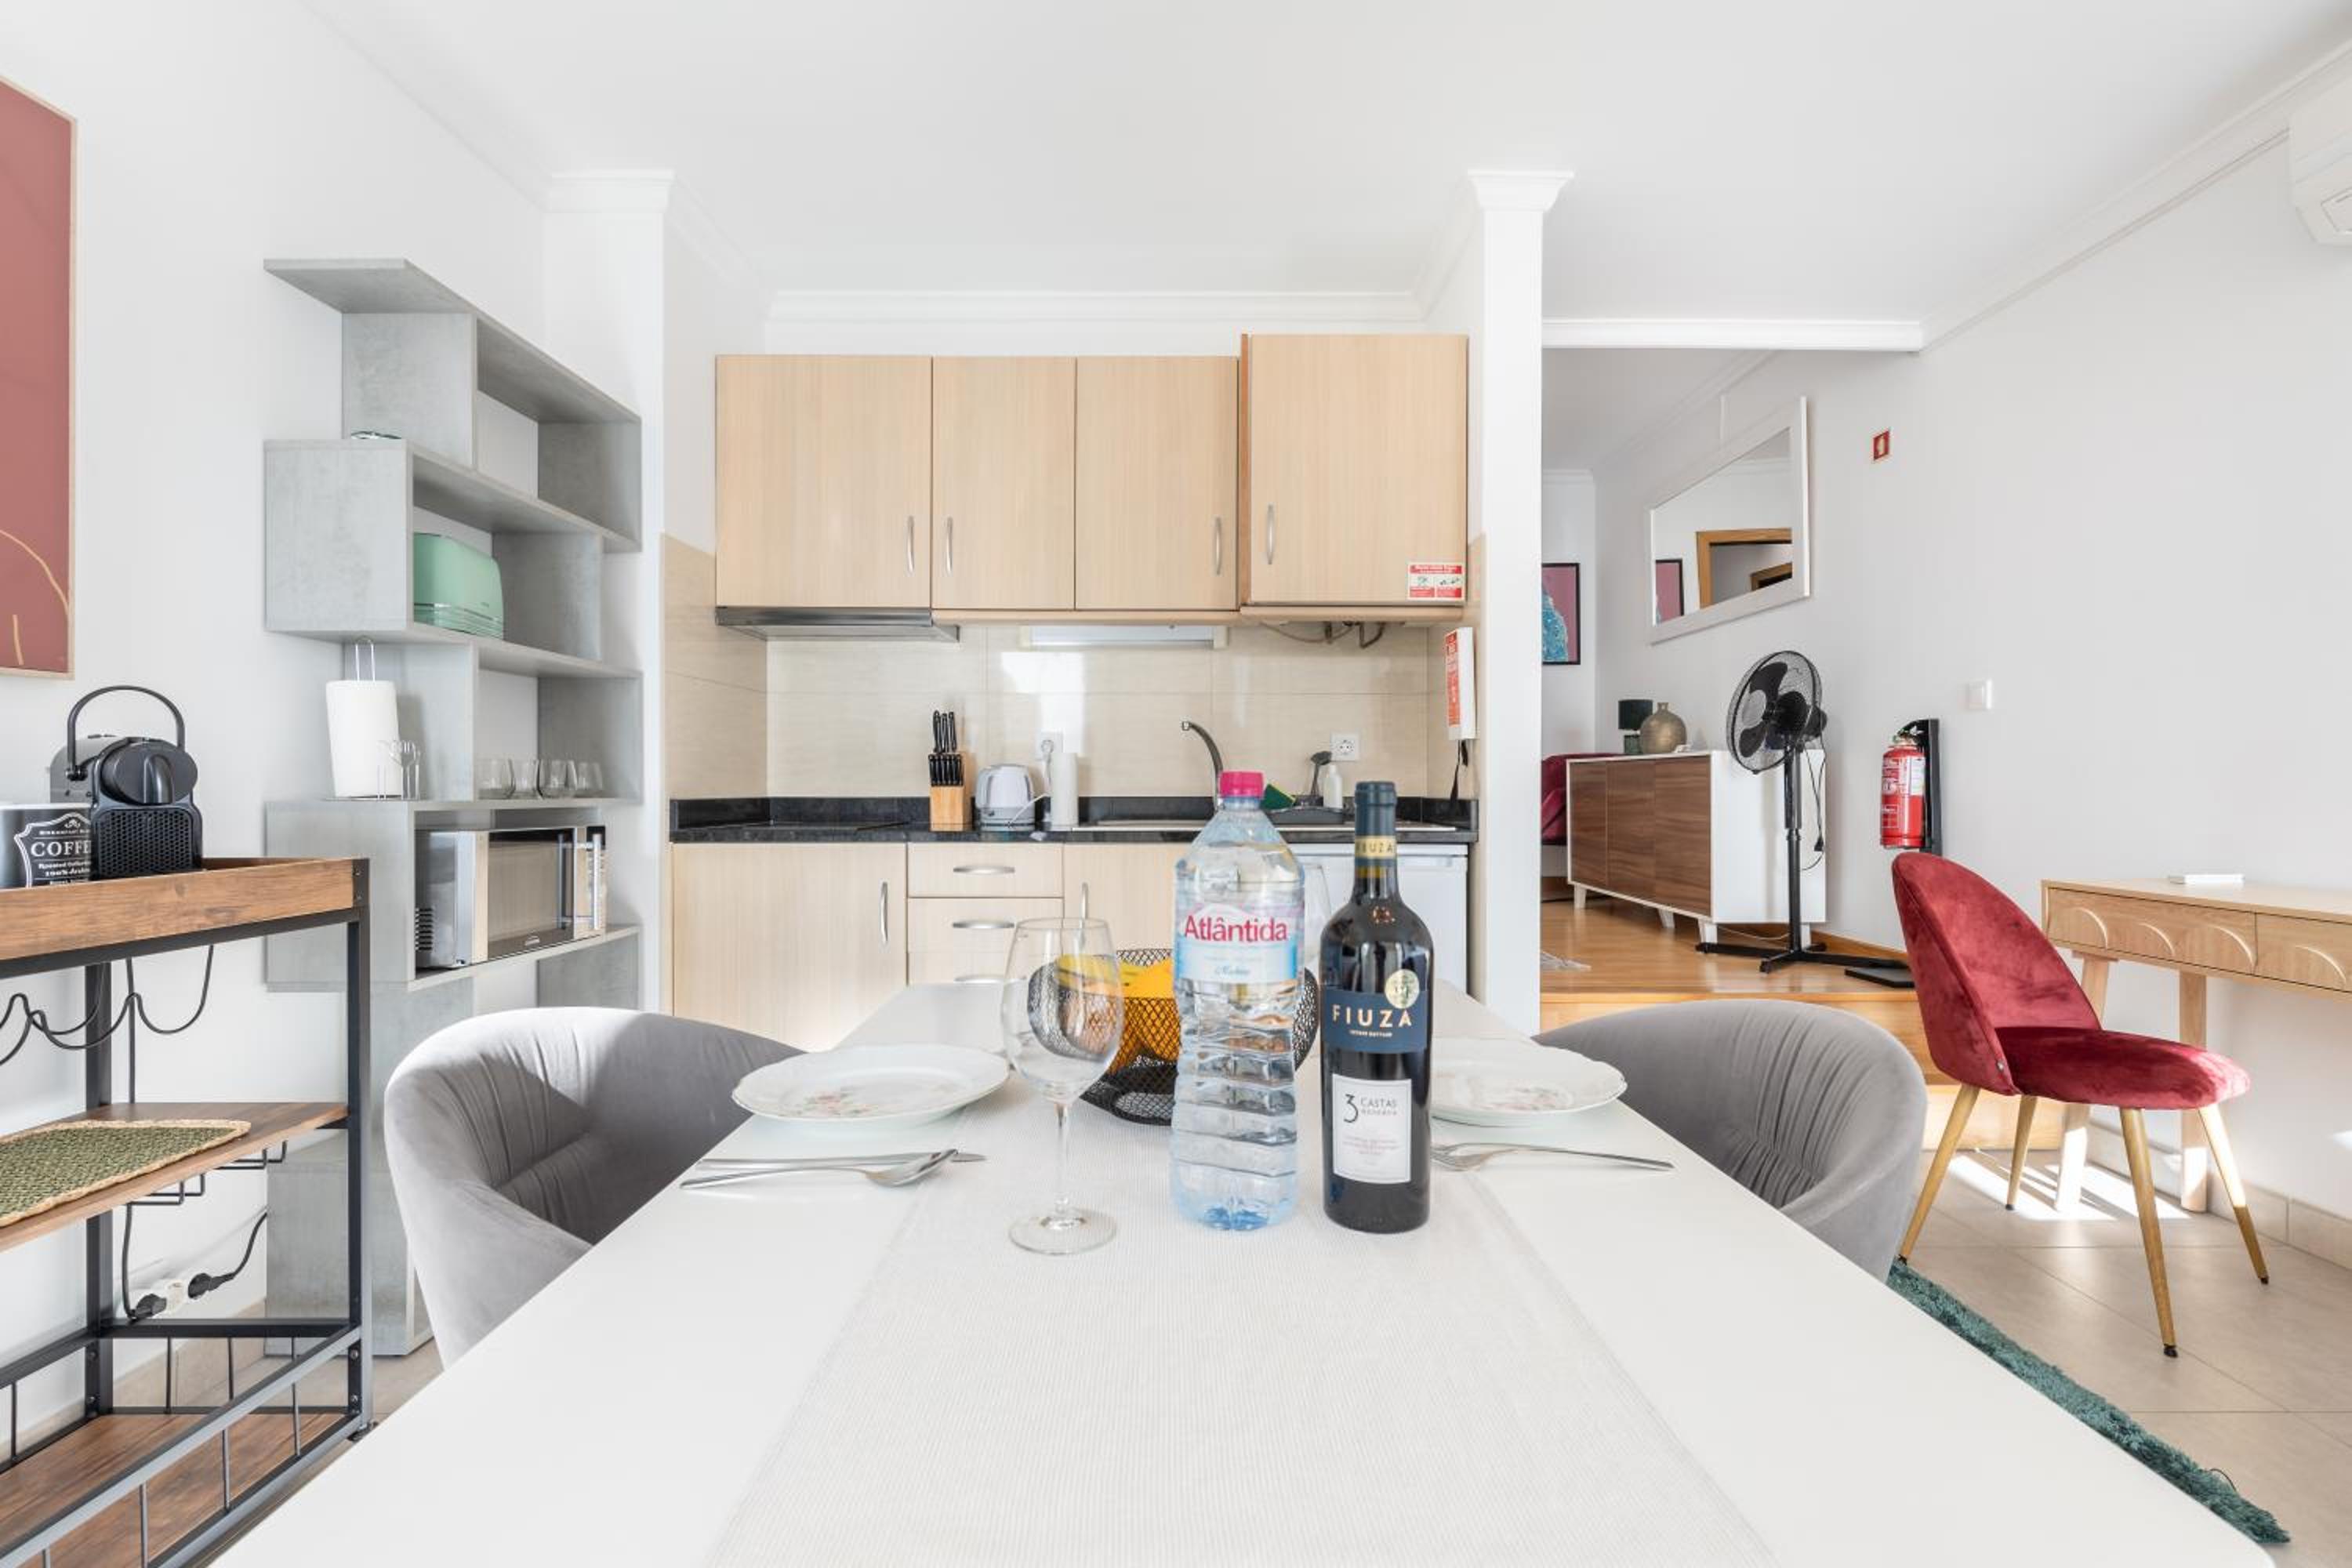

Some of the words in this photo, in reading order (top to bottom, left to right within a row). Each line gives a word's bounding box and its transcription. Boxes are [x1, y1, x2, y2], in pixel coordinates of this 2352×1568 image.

[1185, 915, 1287, 942] Atlântida
[1332, 1004, 1411, 1028] FIUZA
[1344, 1094, 1358, 1123] 3
[1360, 1097, 1398, 1108] CASTAS
